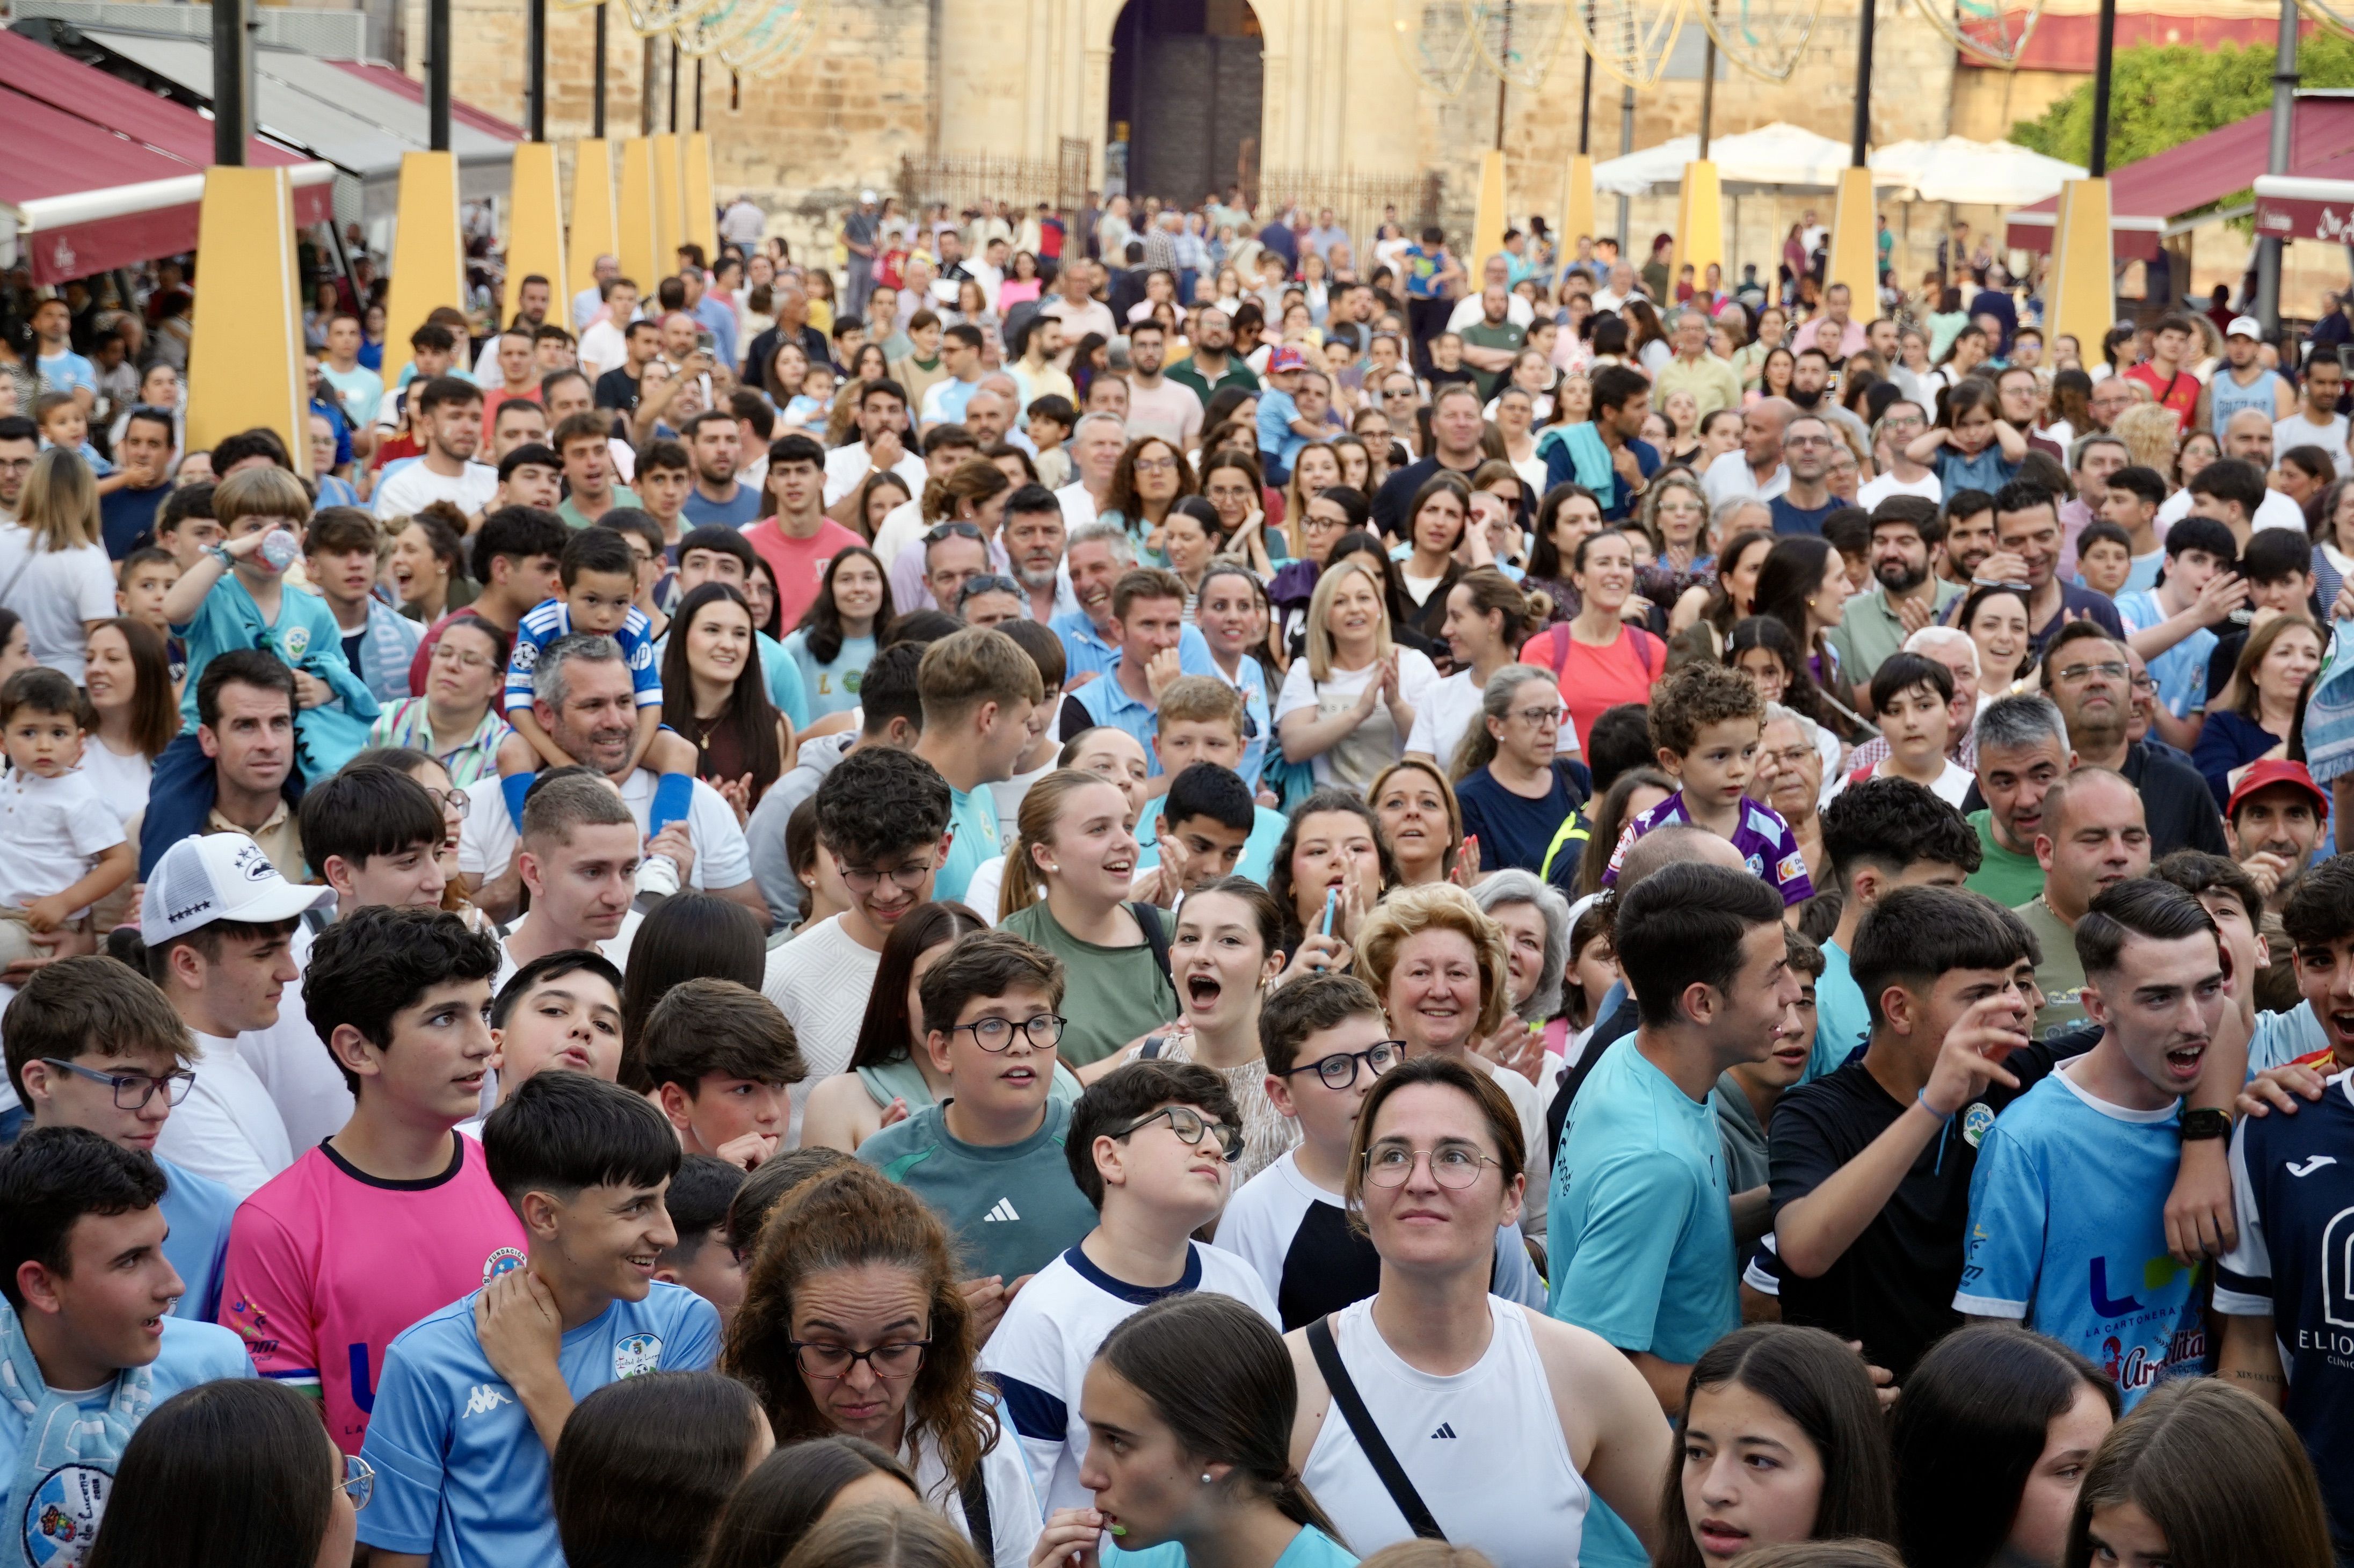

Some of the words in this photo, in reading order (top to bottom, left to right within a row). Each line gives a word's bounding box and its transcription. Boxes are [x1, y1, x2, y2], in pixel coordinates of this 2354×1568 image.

[489, 1248, 525, 1263] FUNDACIÓN
[2086, 1329, 2101, 1338] LA
[2104, 1307, 2176, 1333] CARTONERA
[615, 1354, 634, 1368] Ciudad
